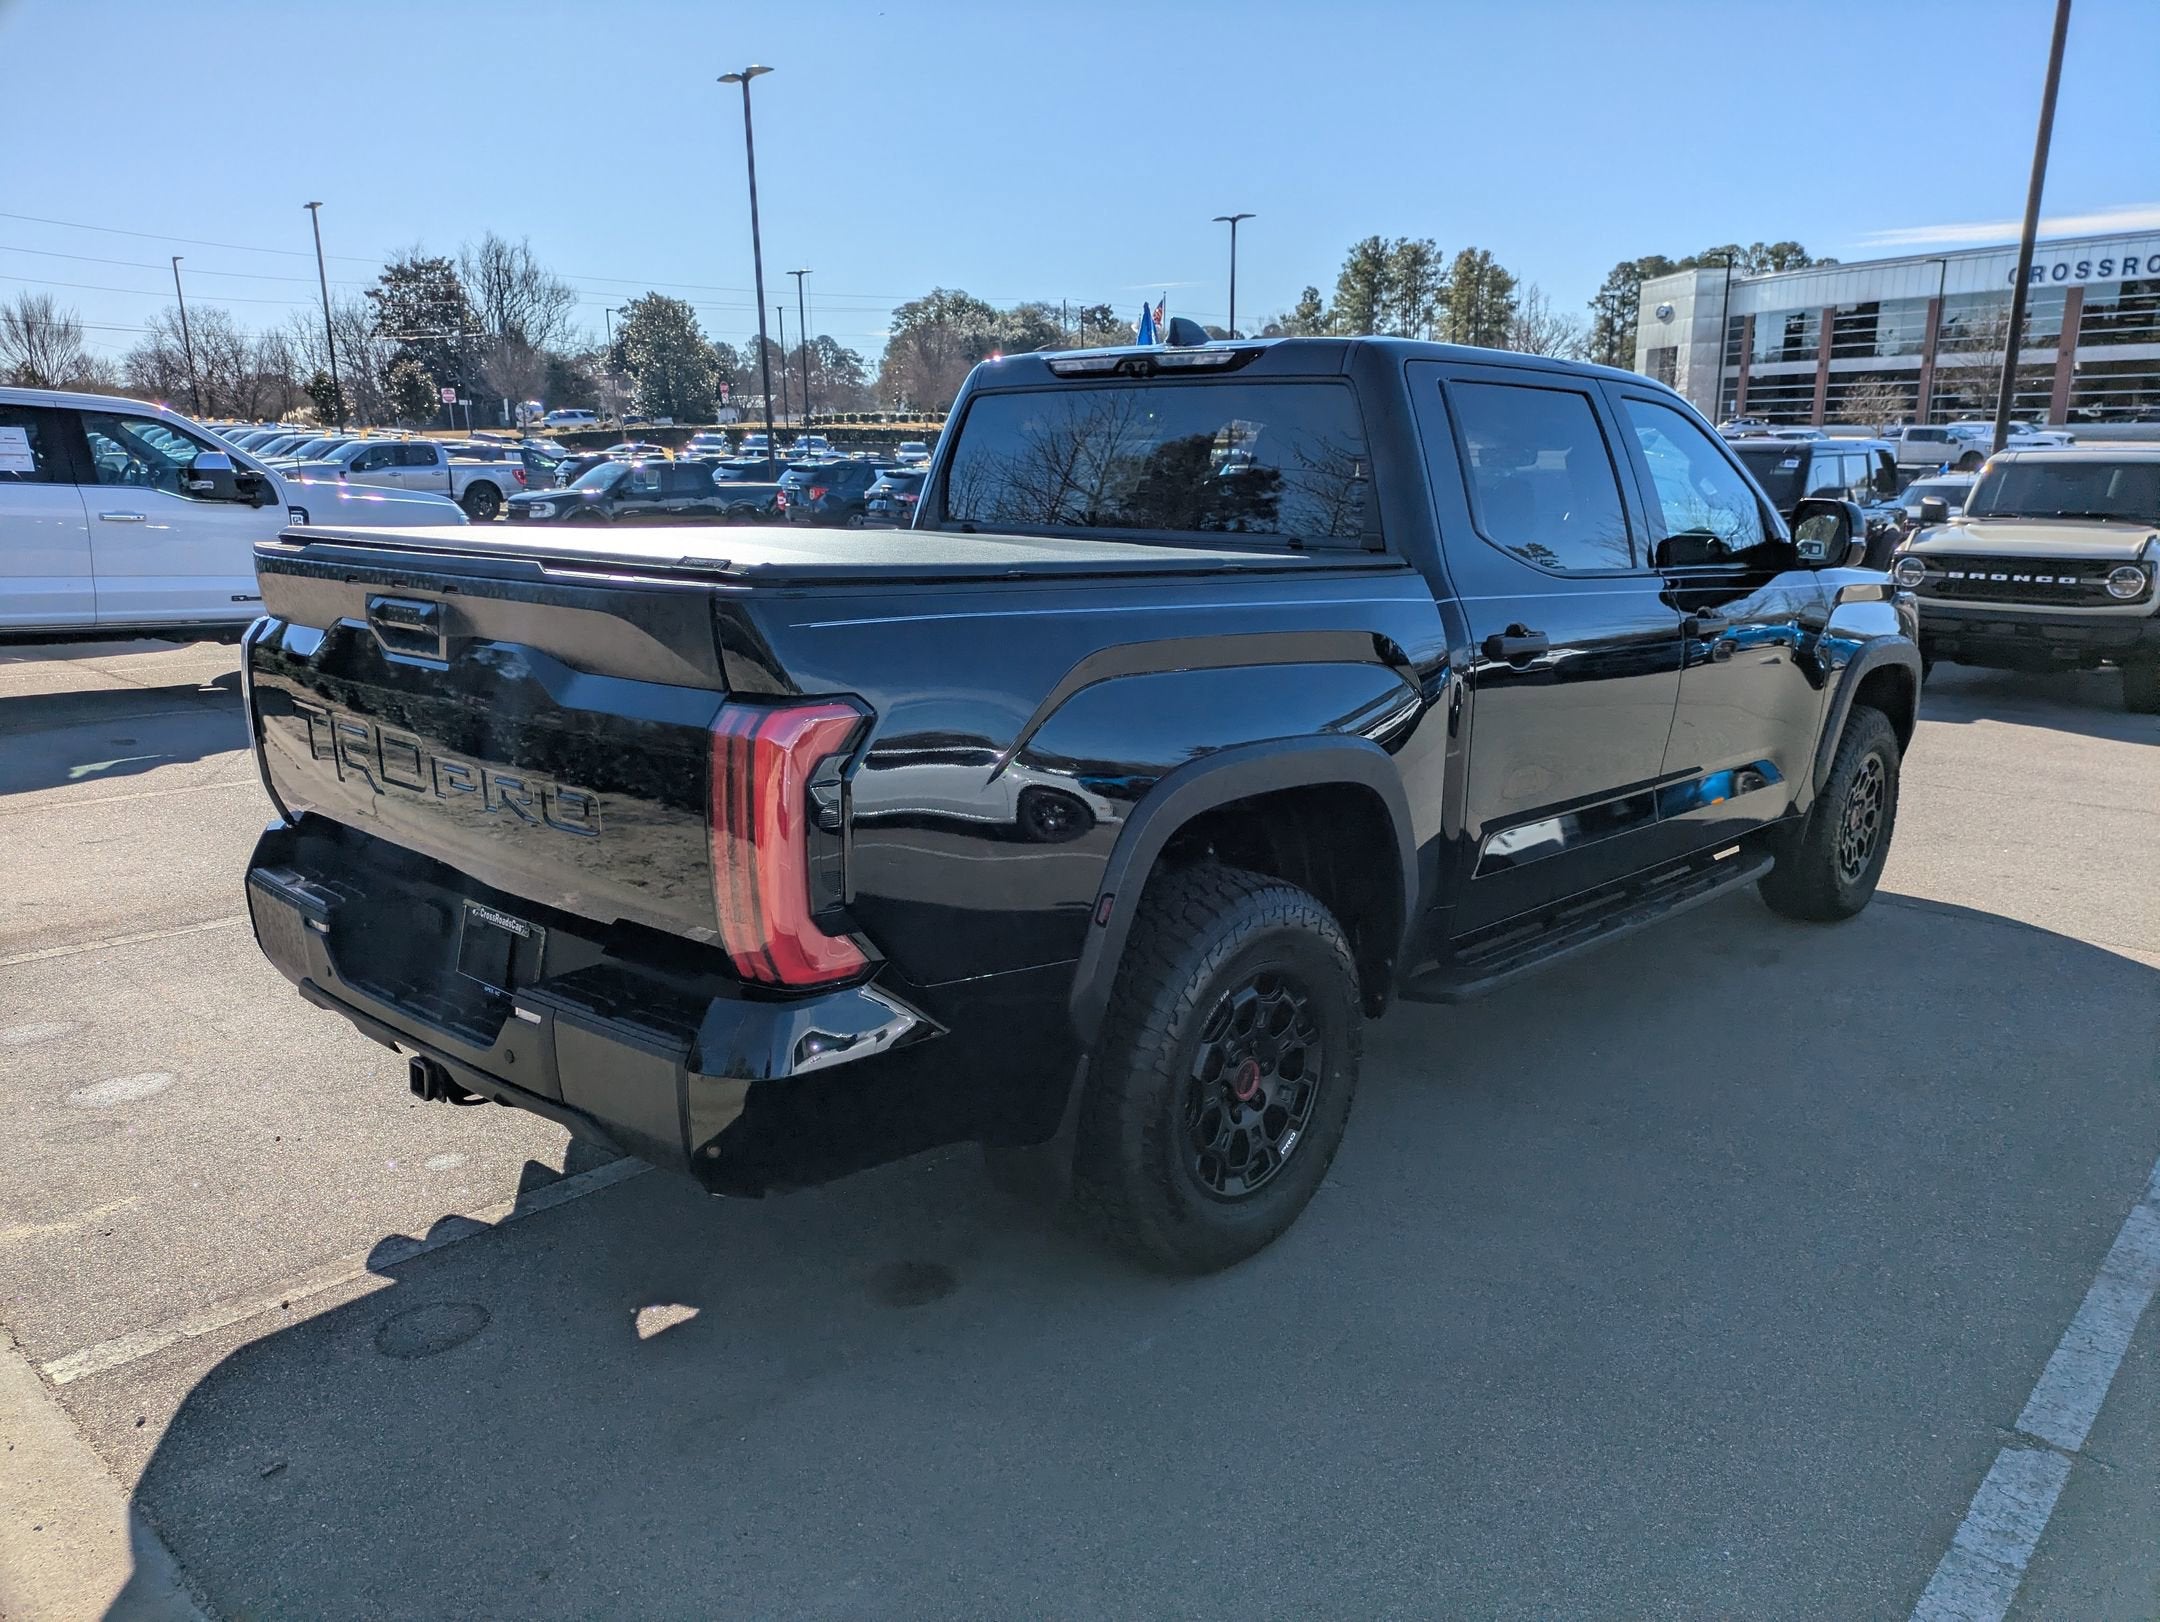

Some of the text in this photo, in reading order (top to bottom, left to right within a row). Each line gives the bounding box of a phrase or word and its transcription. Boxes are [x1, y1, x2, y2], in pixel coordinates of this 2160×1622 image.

[1948, 571, 2077, 584] BRONCO
[291, 698, 602, 836] TRD PRO
